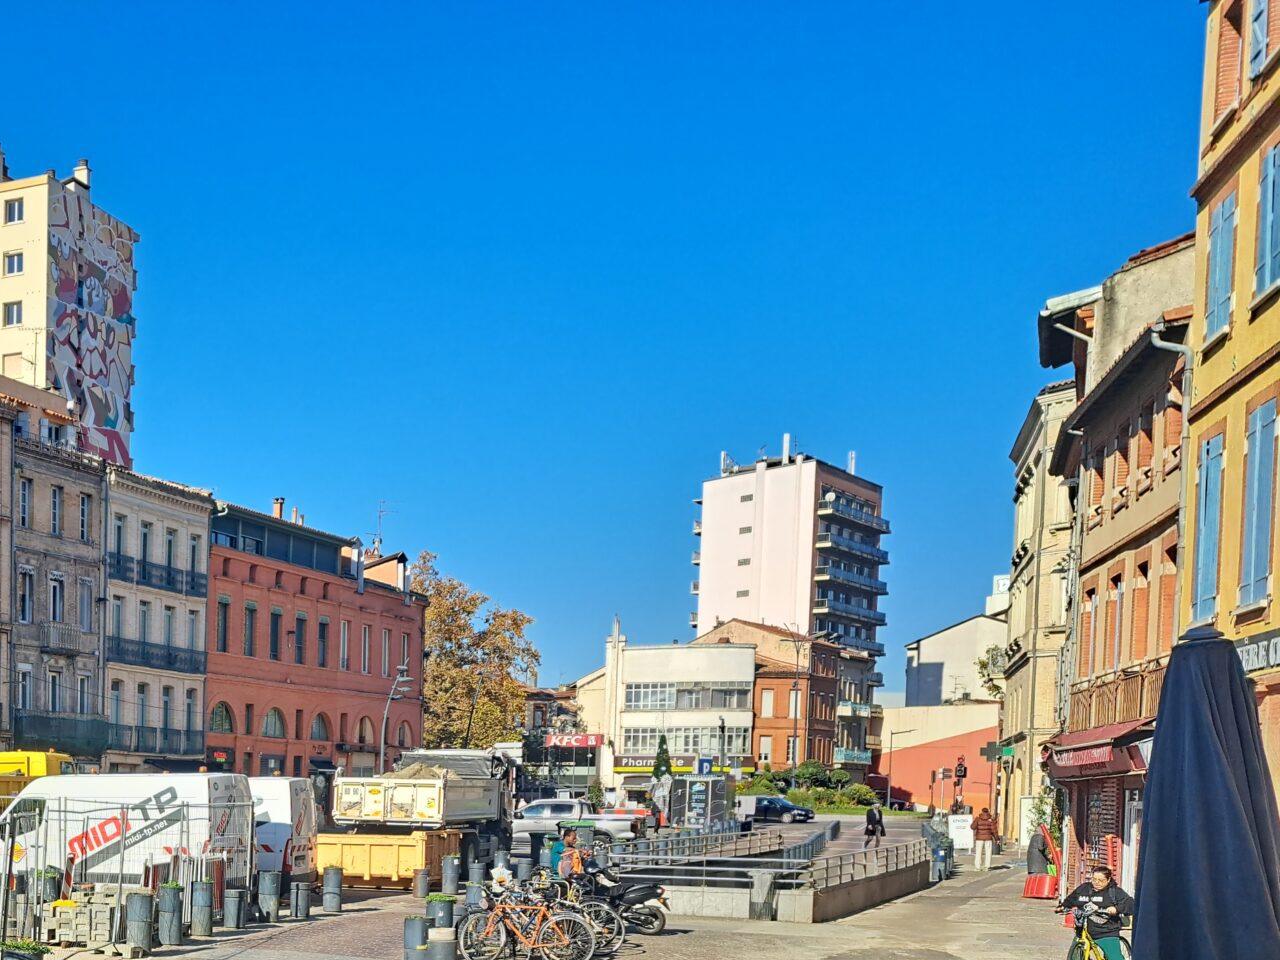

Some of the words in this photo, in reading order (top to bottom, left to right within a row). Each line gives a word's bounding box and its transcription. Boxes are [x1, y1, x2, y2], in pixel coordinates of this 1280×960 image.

[549, 735, 582, 746] KFC
[622, 757, 684, 767] Pharmie
[702, 761, 710, 775] P
[68, 808, 132, 861] MIDI
[131, 786, 178, 823] TP
[125, 820, 169, 848] midi-tp.net
